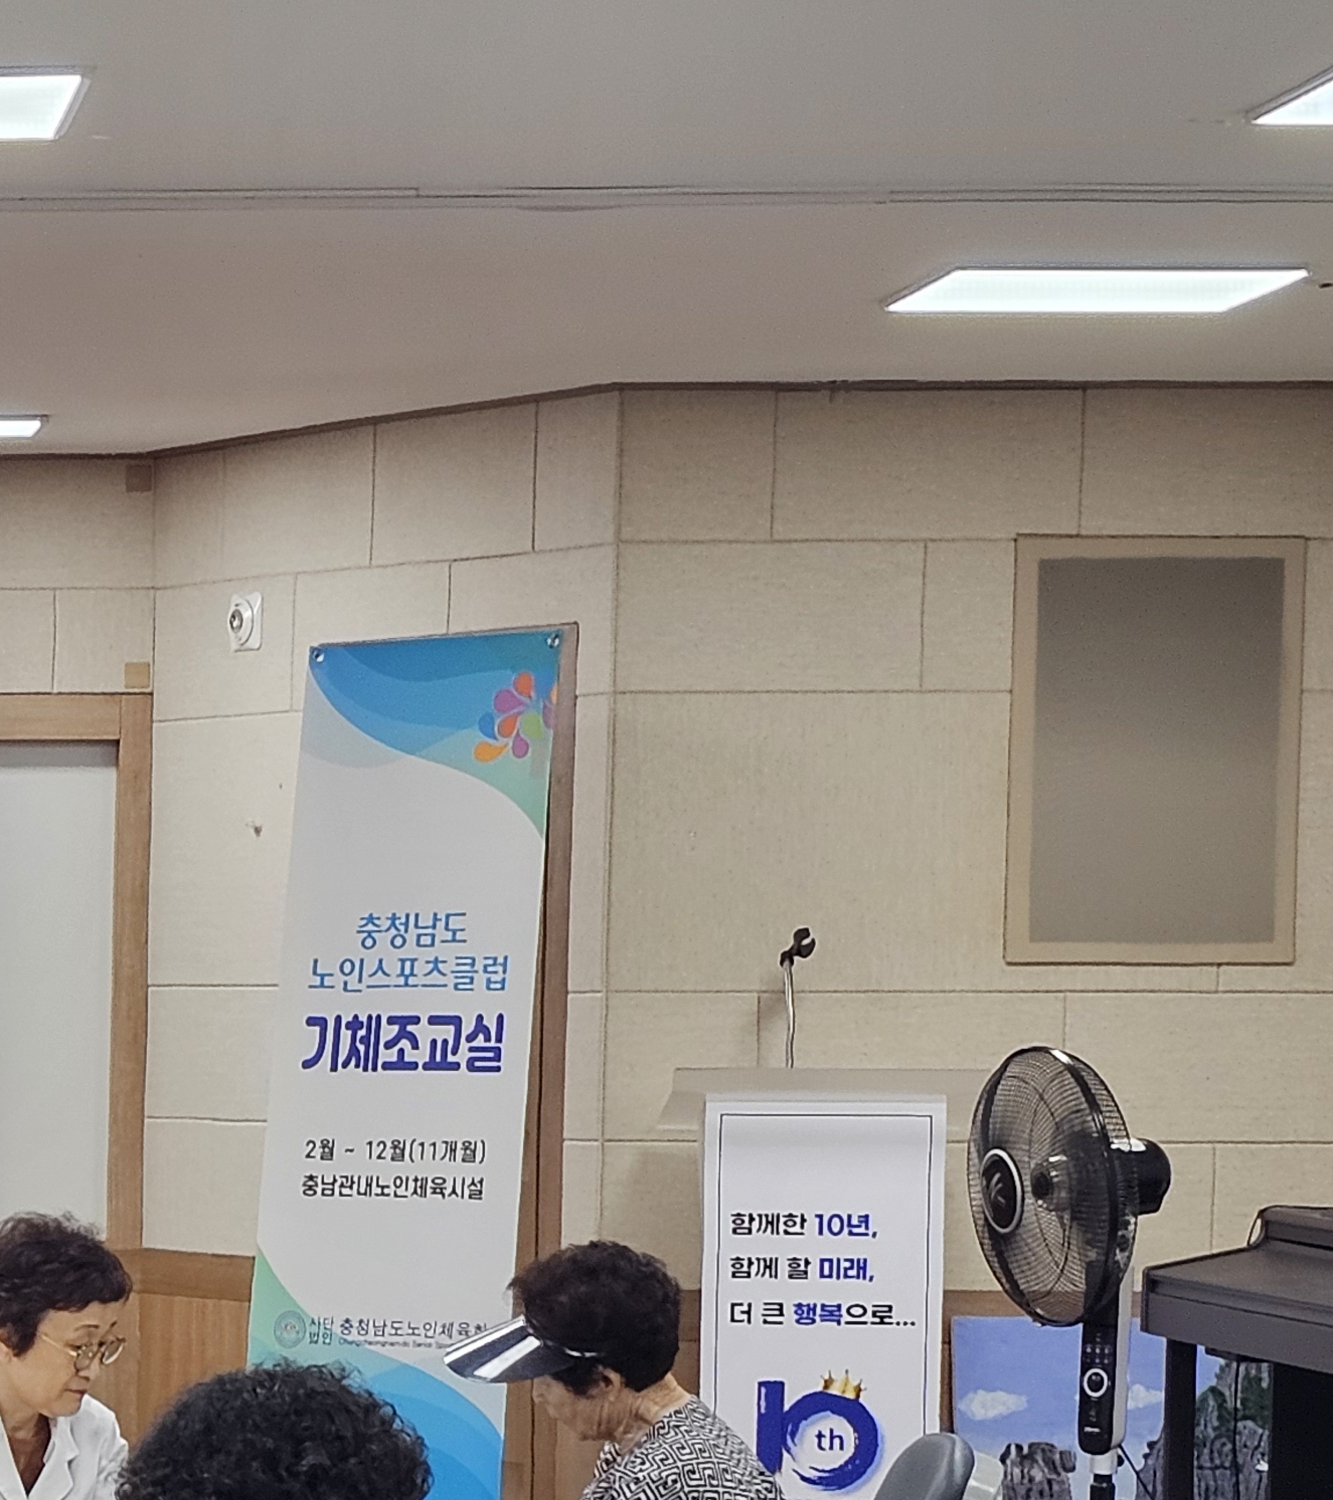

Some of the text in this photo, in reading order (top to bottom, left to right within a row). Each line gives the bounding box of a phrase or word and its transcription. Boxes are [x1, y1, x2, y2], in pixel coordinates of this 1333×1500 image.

[356, 911, 468, 950] 충청남도
[308, 955, 509, 993] 노인스포츠클럽
[301, 1012, 505, 1073] 기체조교실
[304, 1138, 335, 1162] 2월
[365, 1138, 486, 1165] 12월(11개월)
[301, 1173, 485, 1201] 충남관내노인체육시설
[730, 1212, 878, 1239] 함께한 10년,
[729, 1256, 875, 1283] 함께 할 미래,
[729, 1302, 916, 1327] 더 큰 행복으로...
